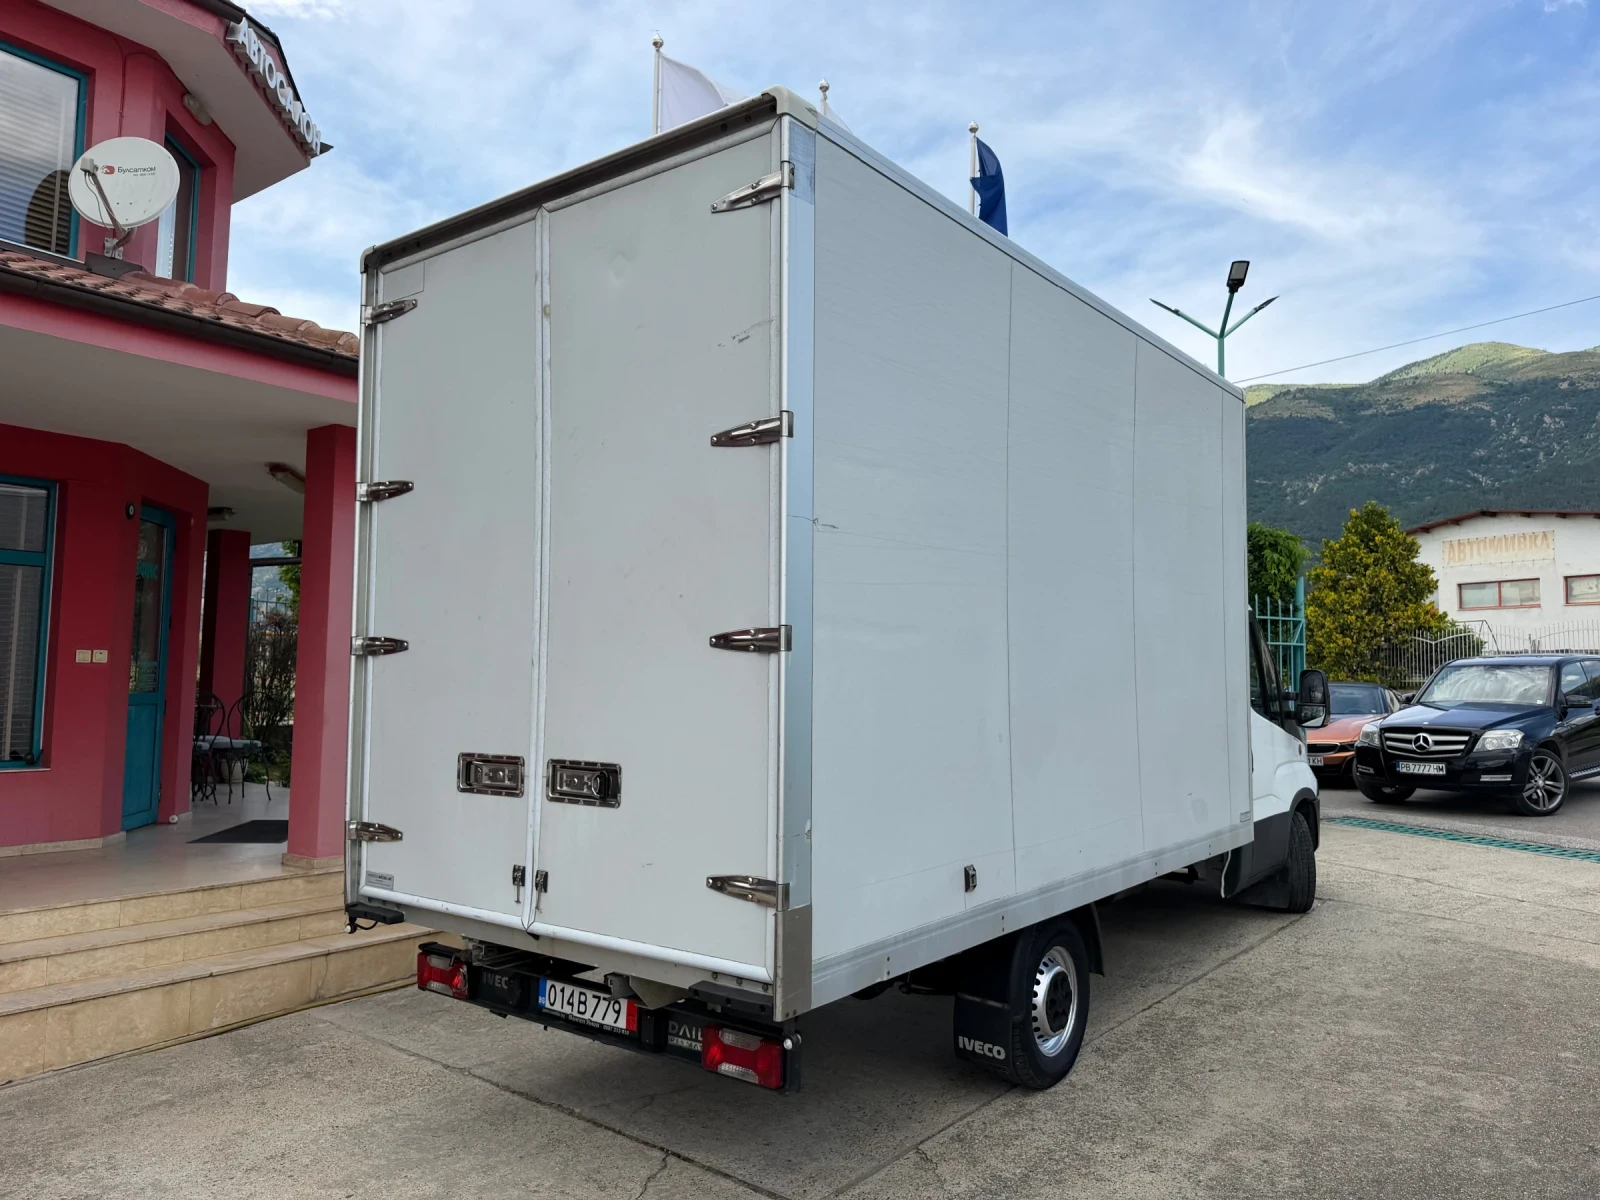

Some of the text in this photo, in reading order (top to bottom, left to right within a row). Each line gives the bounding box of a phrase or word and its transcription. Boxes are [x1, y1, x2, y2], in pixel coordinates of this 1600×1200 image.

[237, 16, 321, 156] АВТОСАЛОН
[117, 166, 156, 175] Булсатком
[1446, 531, 1552, 566] АВТОМИВКА
[482, 971, 512, 990] IVEC
[548, 983, 622, 1025] 014B779
[668, 1020, 703, 1041] DAIL
[958, 1035, 1006, 1060] IVECO
